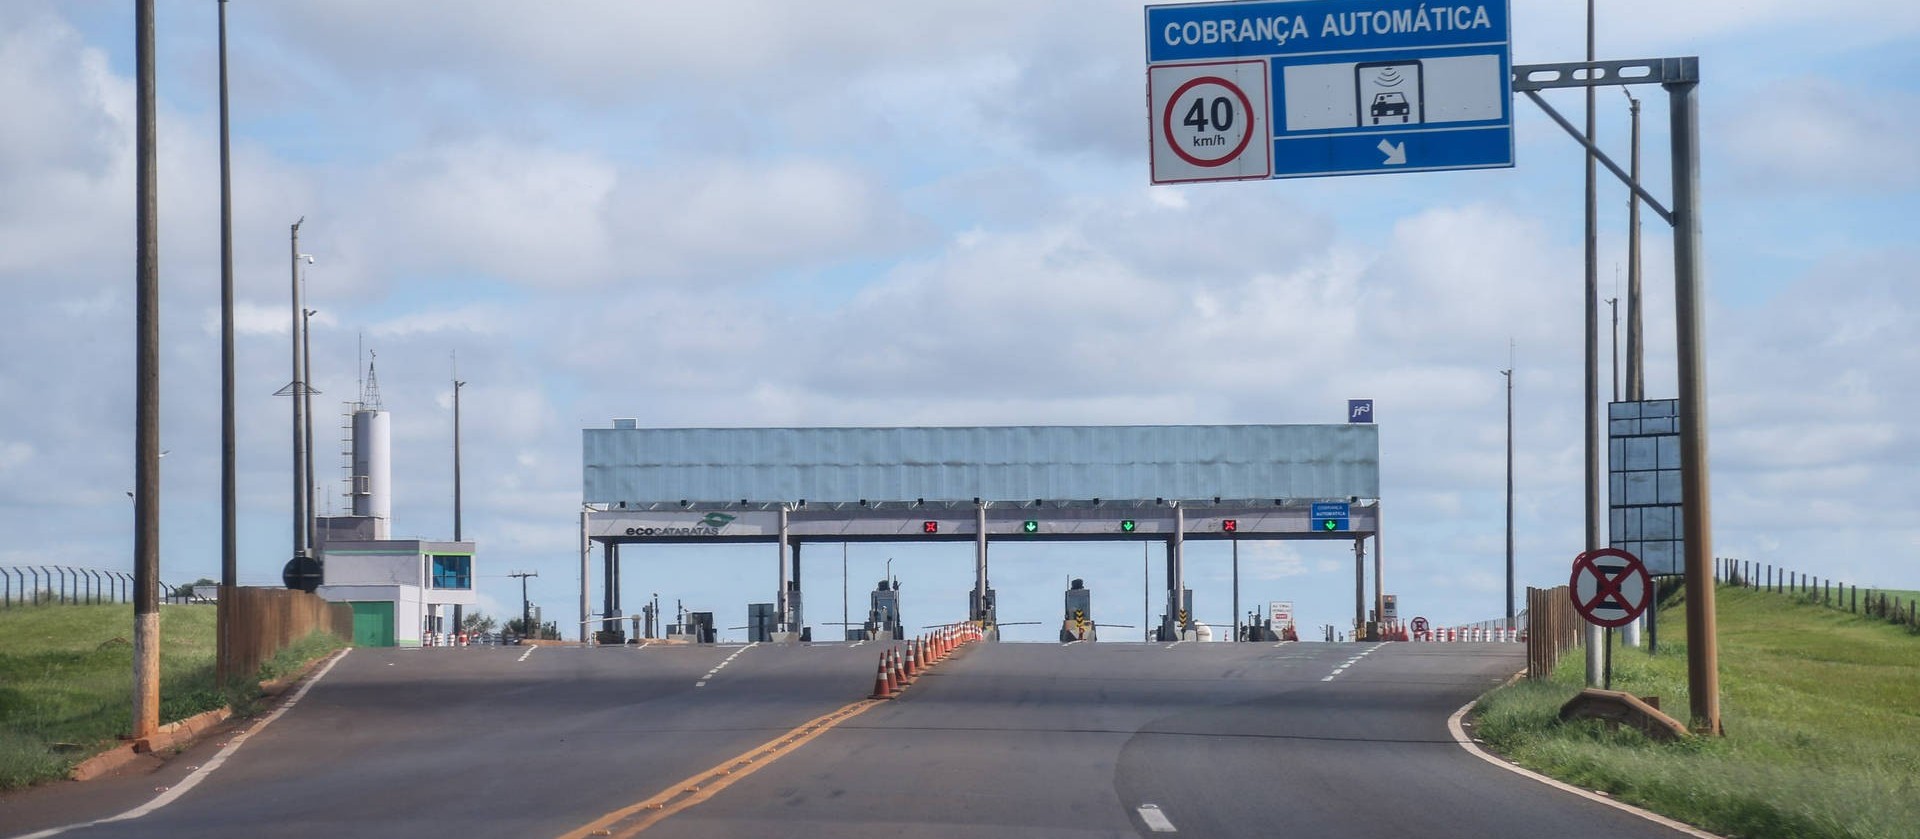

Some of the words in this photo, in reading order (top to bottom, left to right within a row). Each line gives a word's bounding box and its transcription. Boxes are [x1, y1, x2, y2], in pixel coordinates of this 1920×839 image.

[1164, 15, 1309, 46] COBRANÇA
[1321, 3, 1492, 38] AUTOMÁTICA
[1183, 96, 1234, 132] 40
[1193, 134, 1226, 147] km/h
